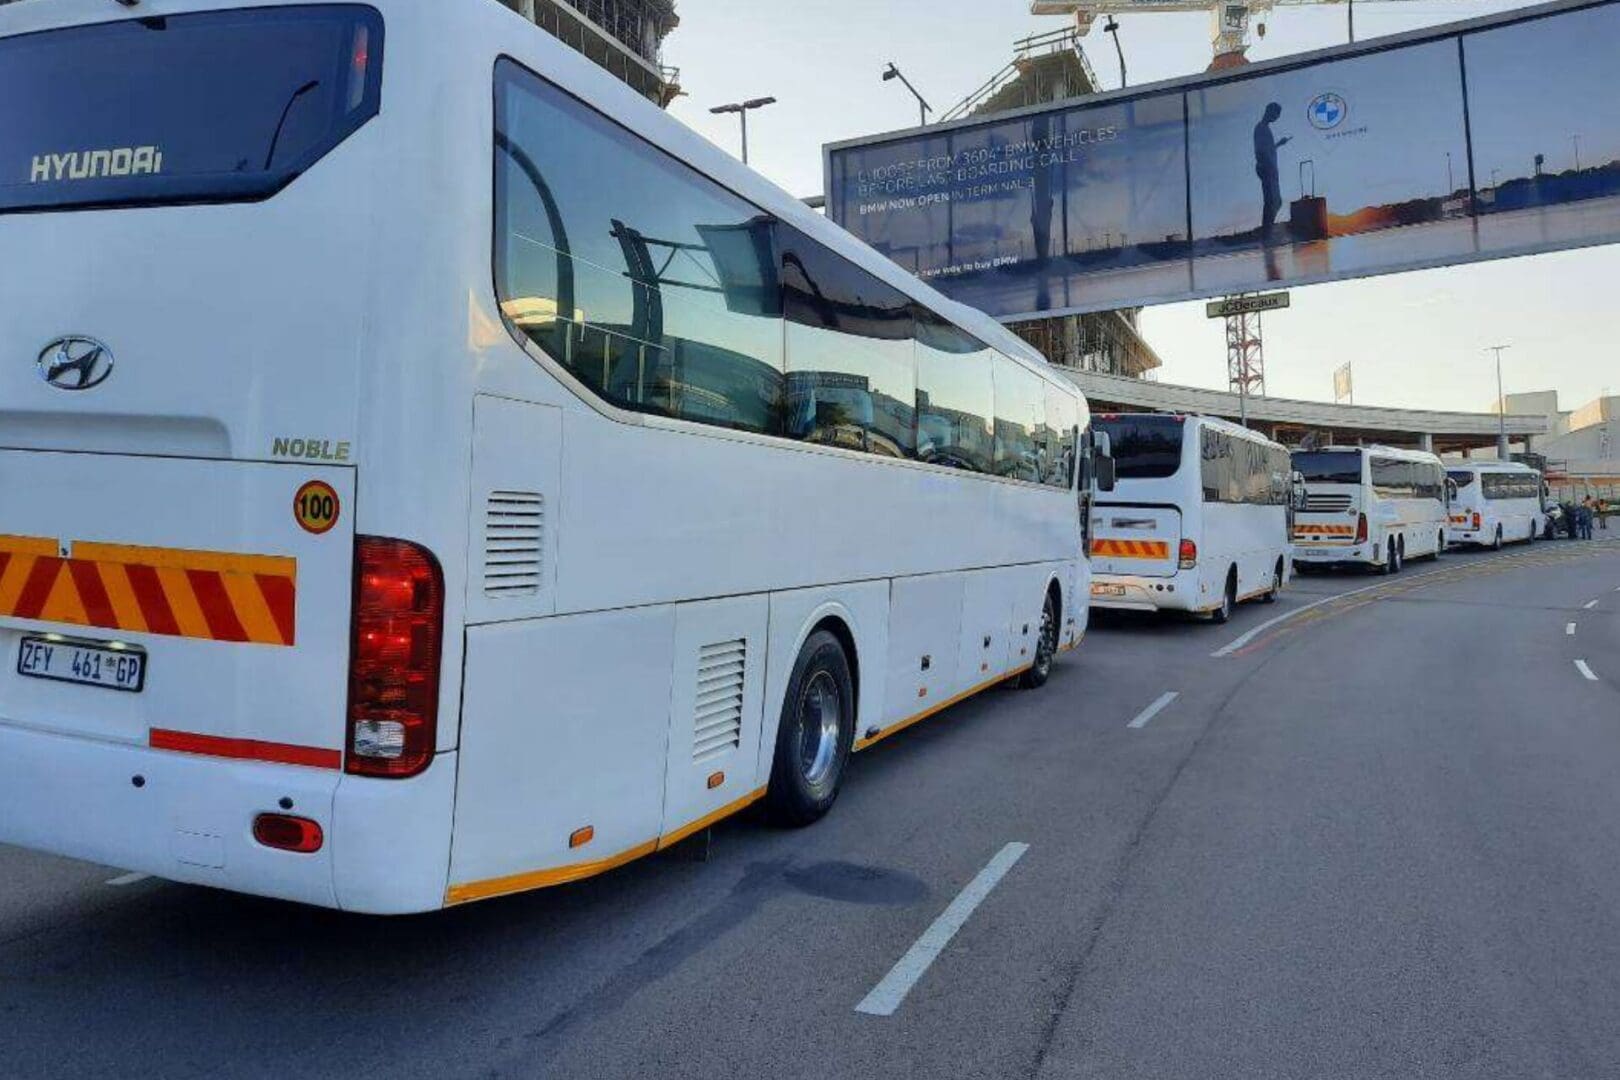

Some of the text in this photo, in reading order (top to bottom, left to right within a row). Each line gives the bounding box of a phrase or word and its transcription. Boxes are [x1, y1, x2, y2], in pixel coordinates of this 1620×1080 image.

[918, 156, 957, 172] FROM
[1005, 139, 1041, 156] BMW
[1043, 126, 1118, 150] VEHICLES
[858, 150, 1078, 197] BEFORE LAST BOARDING CALL
[859, 201, 887, 215] BMW
[889, 196, 915, 210] NOW
[917, 192, 950, 206] OPEN
[951, 189, 964, 200] IN
[967, 179, 1025, 198] TERMINAL
[974, 260, 991, 271] buy
[992, 256, 1018, 267] BMW
[1218, 297, 1279, 313] JCDecaux
[272, 437, 351, 460] NOBLE
[301, 493, 334, 521] 100
[24, 643, 138, 684] ZFY 461 GP
